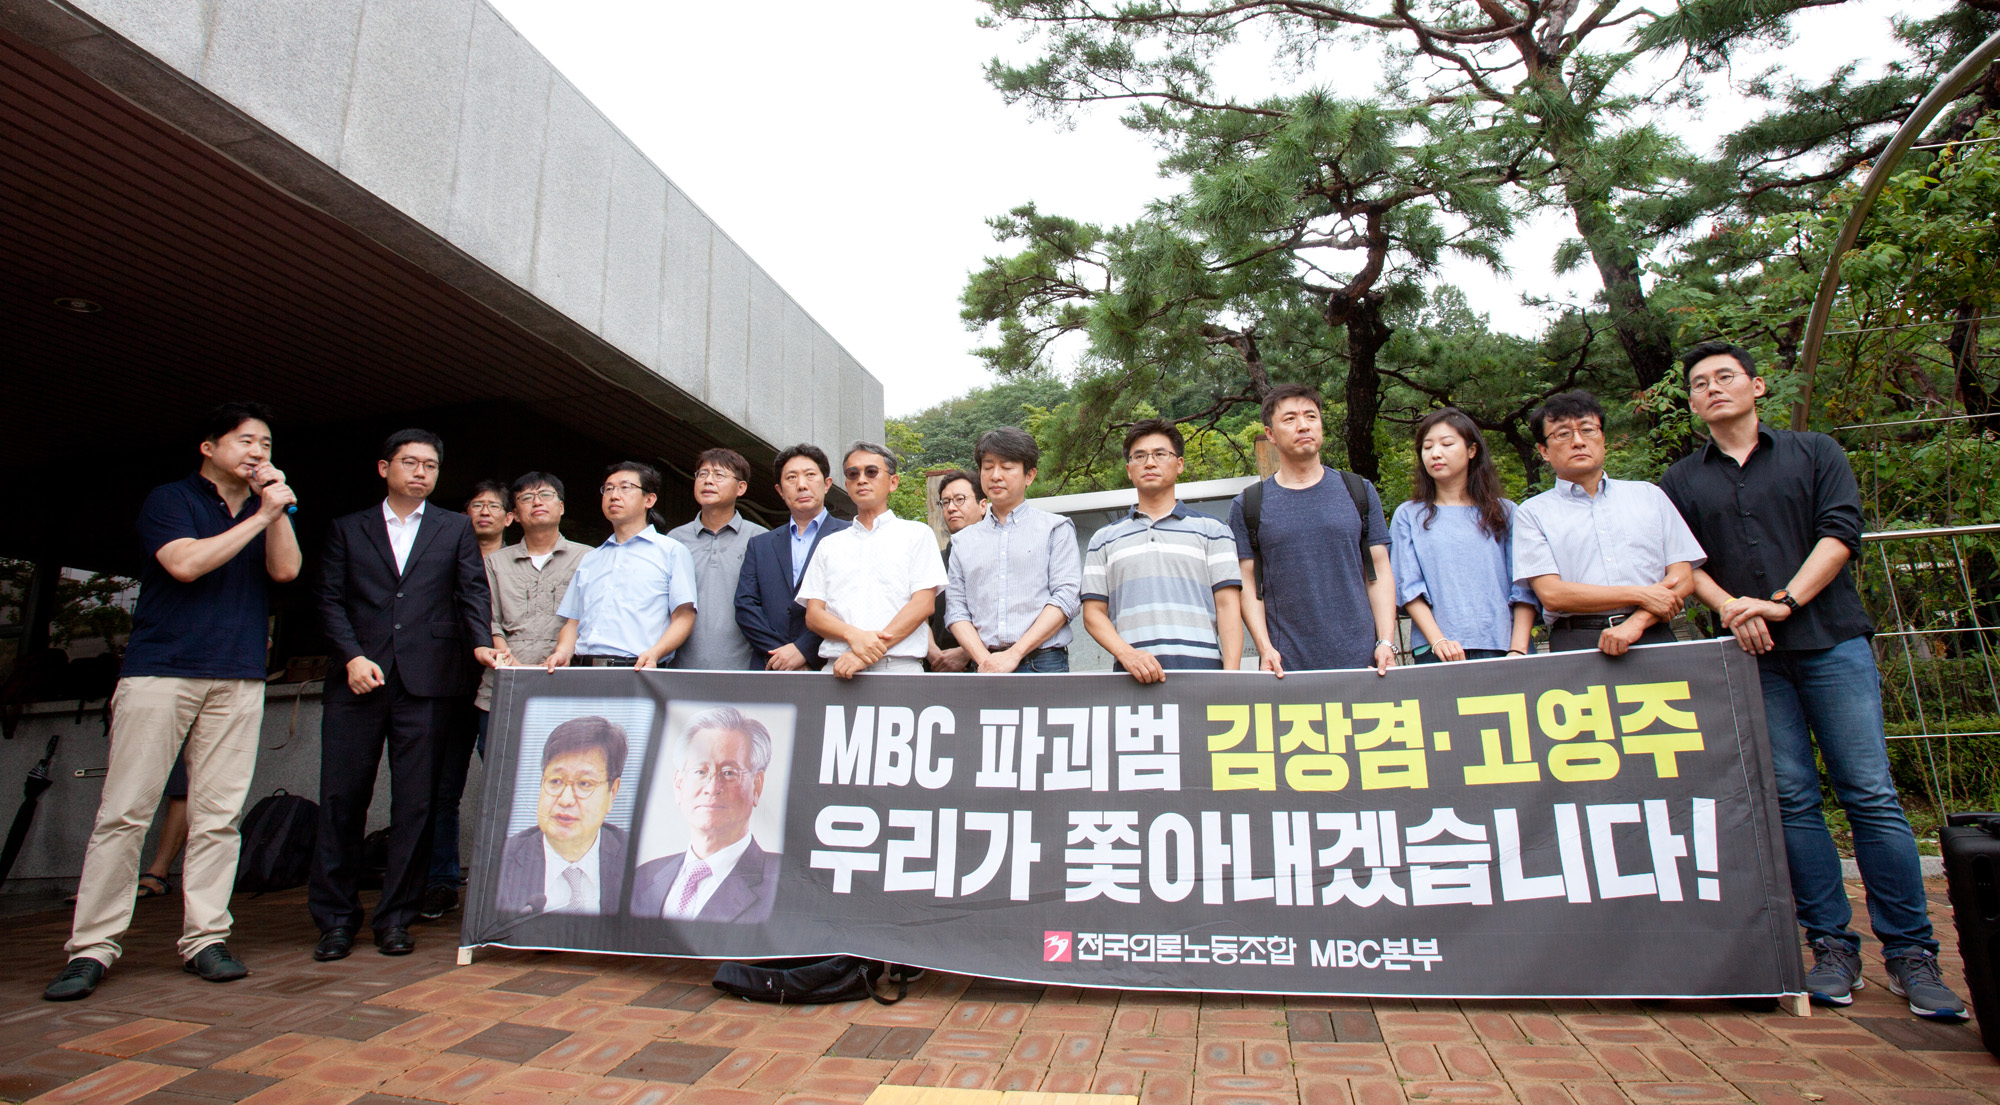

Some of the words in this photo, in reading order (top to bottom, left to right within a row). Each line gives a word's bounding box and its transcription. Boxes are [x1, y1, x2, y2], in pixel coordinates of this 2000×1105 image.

[819, 704, 955, 789] MBC
[975, 704, 1181, 792] 파괴범
[810, 805, 1041, 901] 우리가
[1065, 797, 1720, 908] 쫓아내겠습니다!
[1077, 932, 1297, 966] 전국언론노동조합
[1310, 937, 1443, 971] MBC본부
